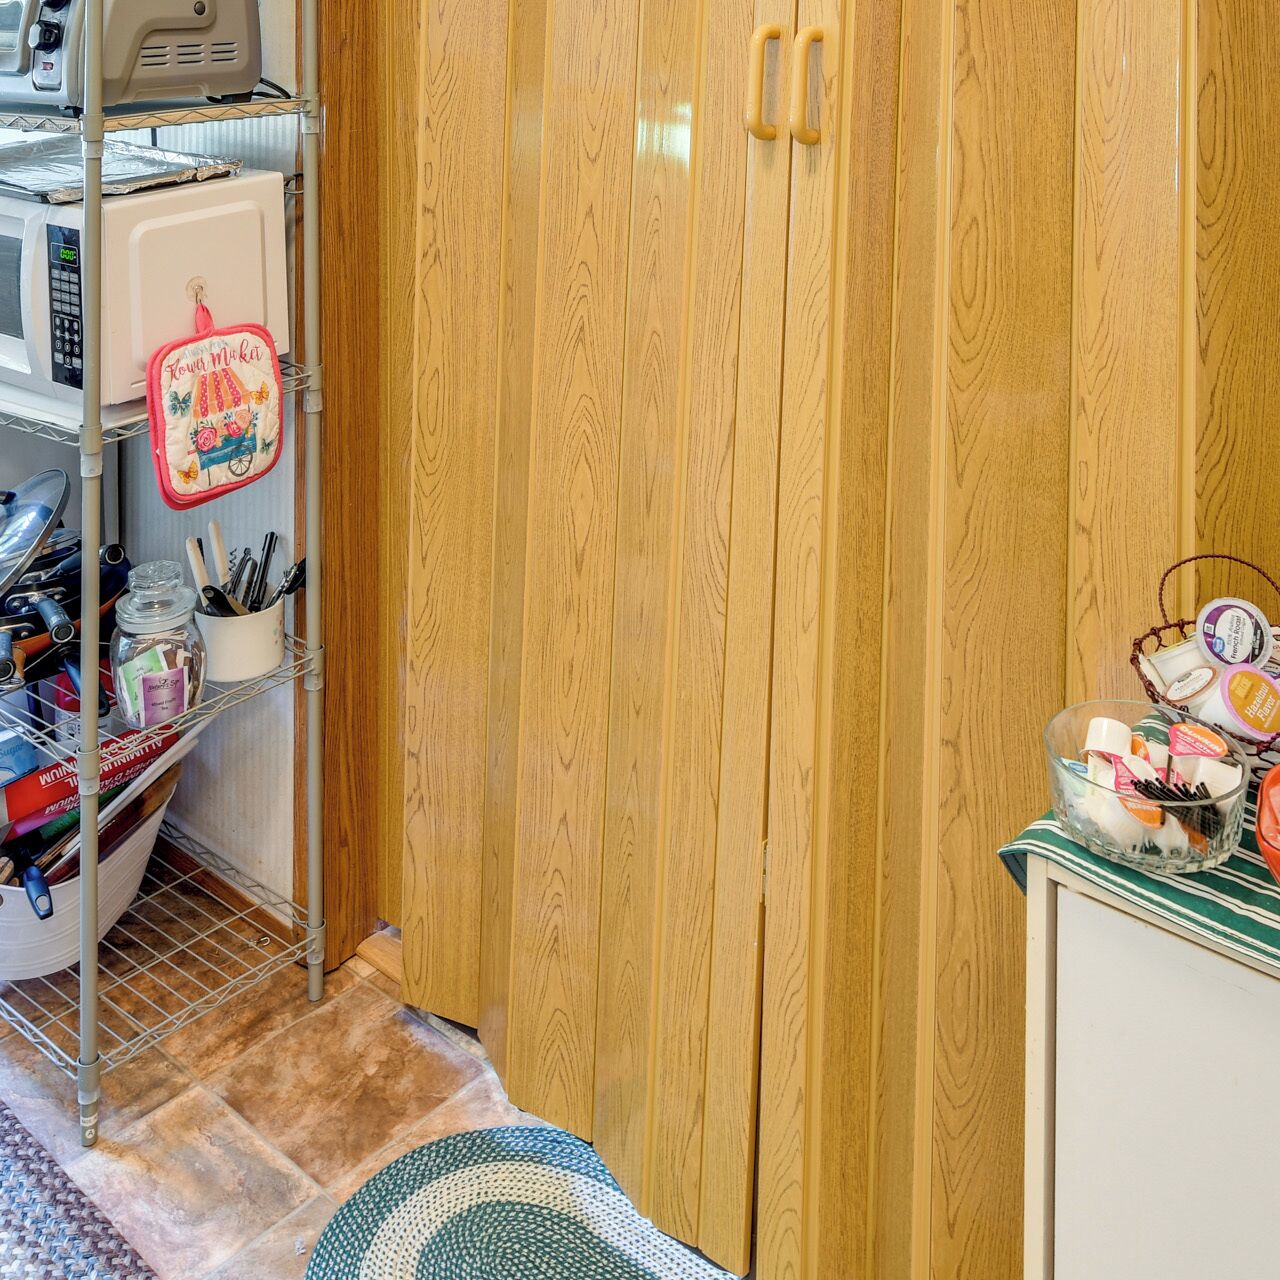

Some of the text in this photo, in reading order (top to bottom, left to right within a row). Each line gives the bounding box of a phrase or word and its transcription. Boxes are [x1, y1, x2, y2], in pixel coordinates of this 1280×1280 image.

[1231, 615, 1241, 659] French Roast
[1245, 682, 1269, 718] Hazelnut
[1256, 695, 1276, 722] Flavor
